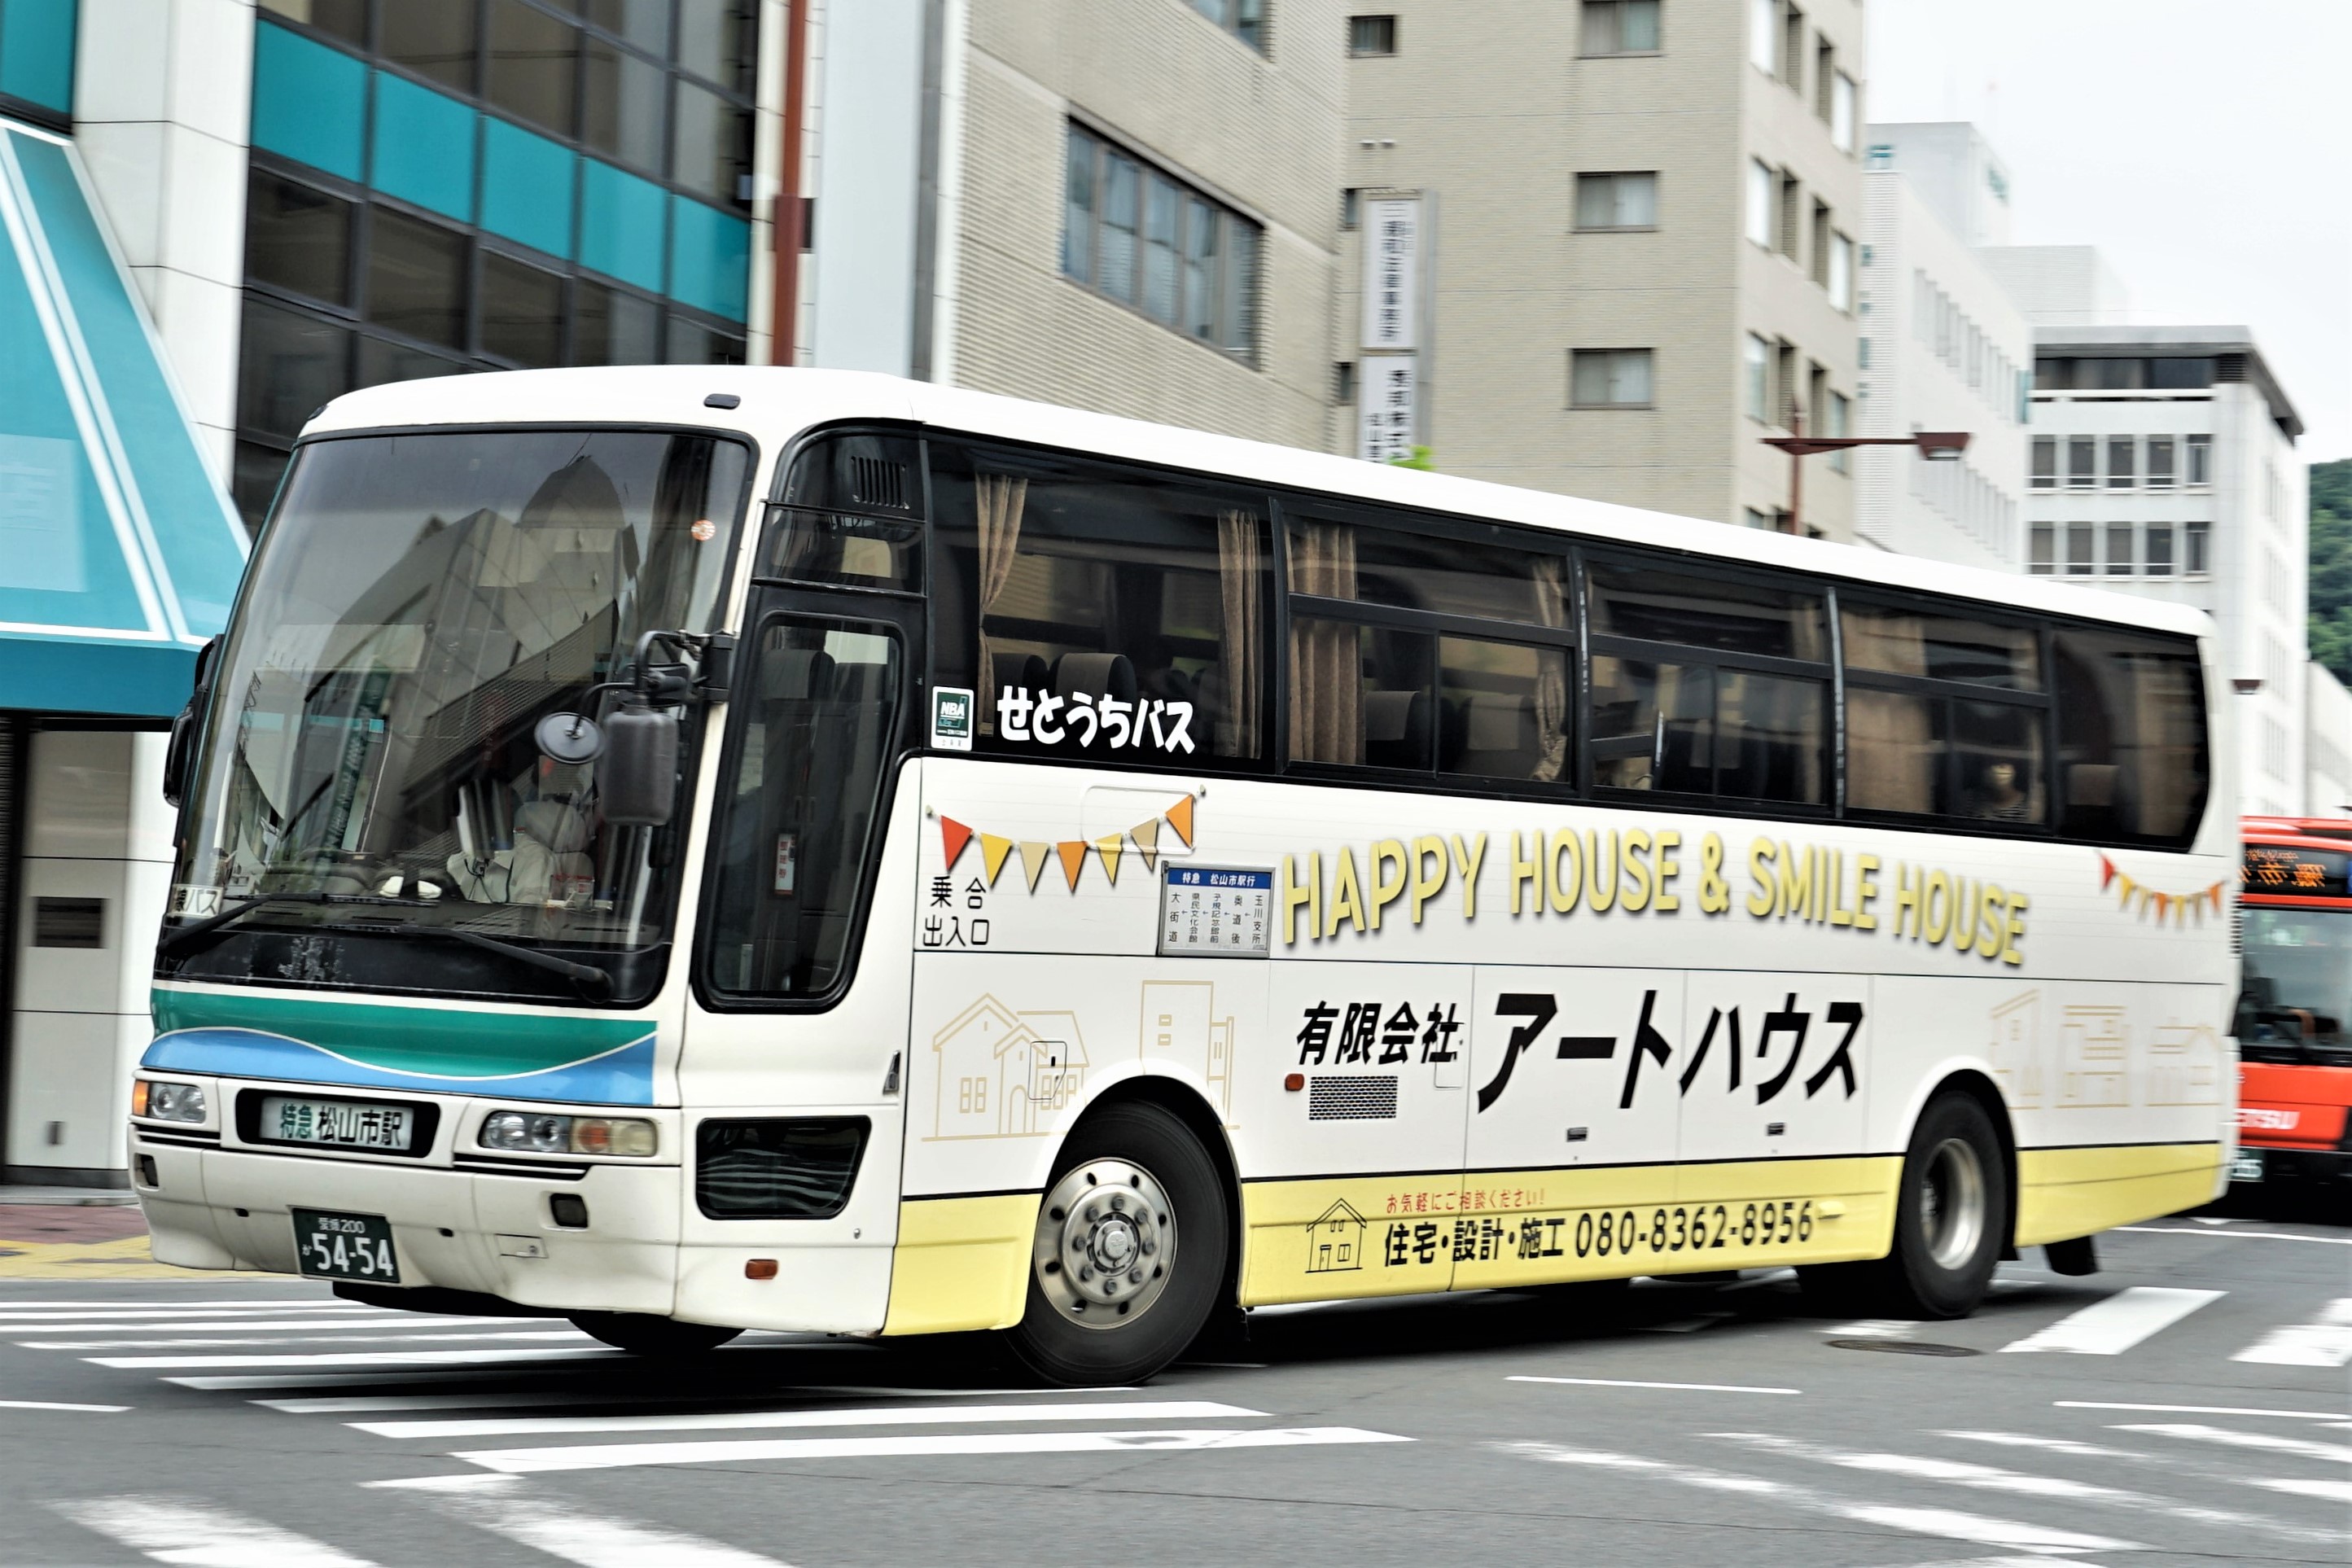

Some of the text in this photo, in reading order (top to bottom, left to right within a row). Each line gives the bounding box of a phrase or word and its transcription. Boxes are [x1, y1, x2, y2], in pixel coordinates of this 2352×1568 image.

[940, 701, 966, 716] NBA
[997, 685, 1195, 754] せとうちバス
[931, 875, 987, 909] 乗合
[1182, 872, 1256, 887] 特急 松山市駅行
[1284, 828, 2028, 965] HAPPY HOUSE & SMILE HOUSE
[922, 913, 990, 947] 出入口
[1168, 892, 1182, 943] 大街道
[1189, 892, 1200, 943] 県民文化会館
[1232, 895, 1243, 944] 奥道後
[1296, 989, 1864, 1113] 有限会社 アートハウス
[312, 1233, 394, 1277] 54-54
[1385, 1201, 1813, 1266] 住宅・設計・施工 080-8362-8956
